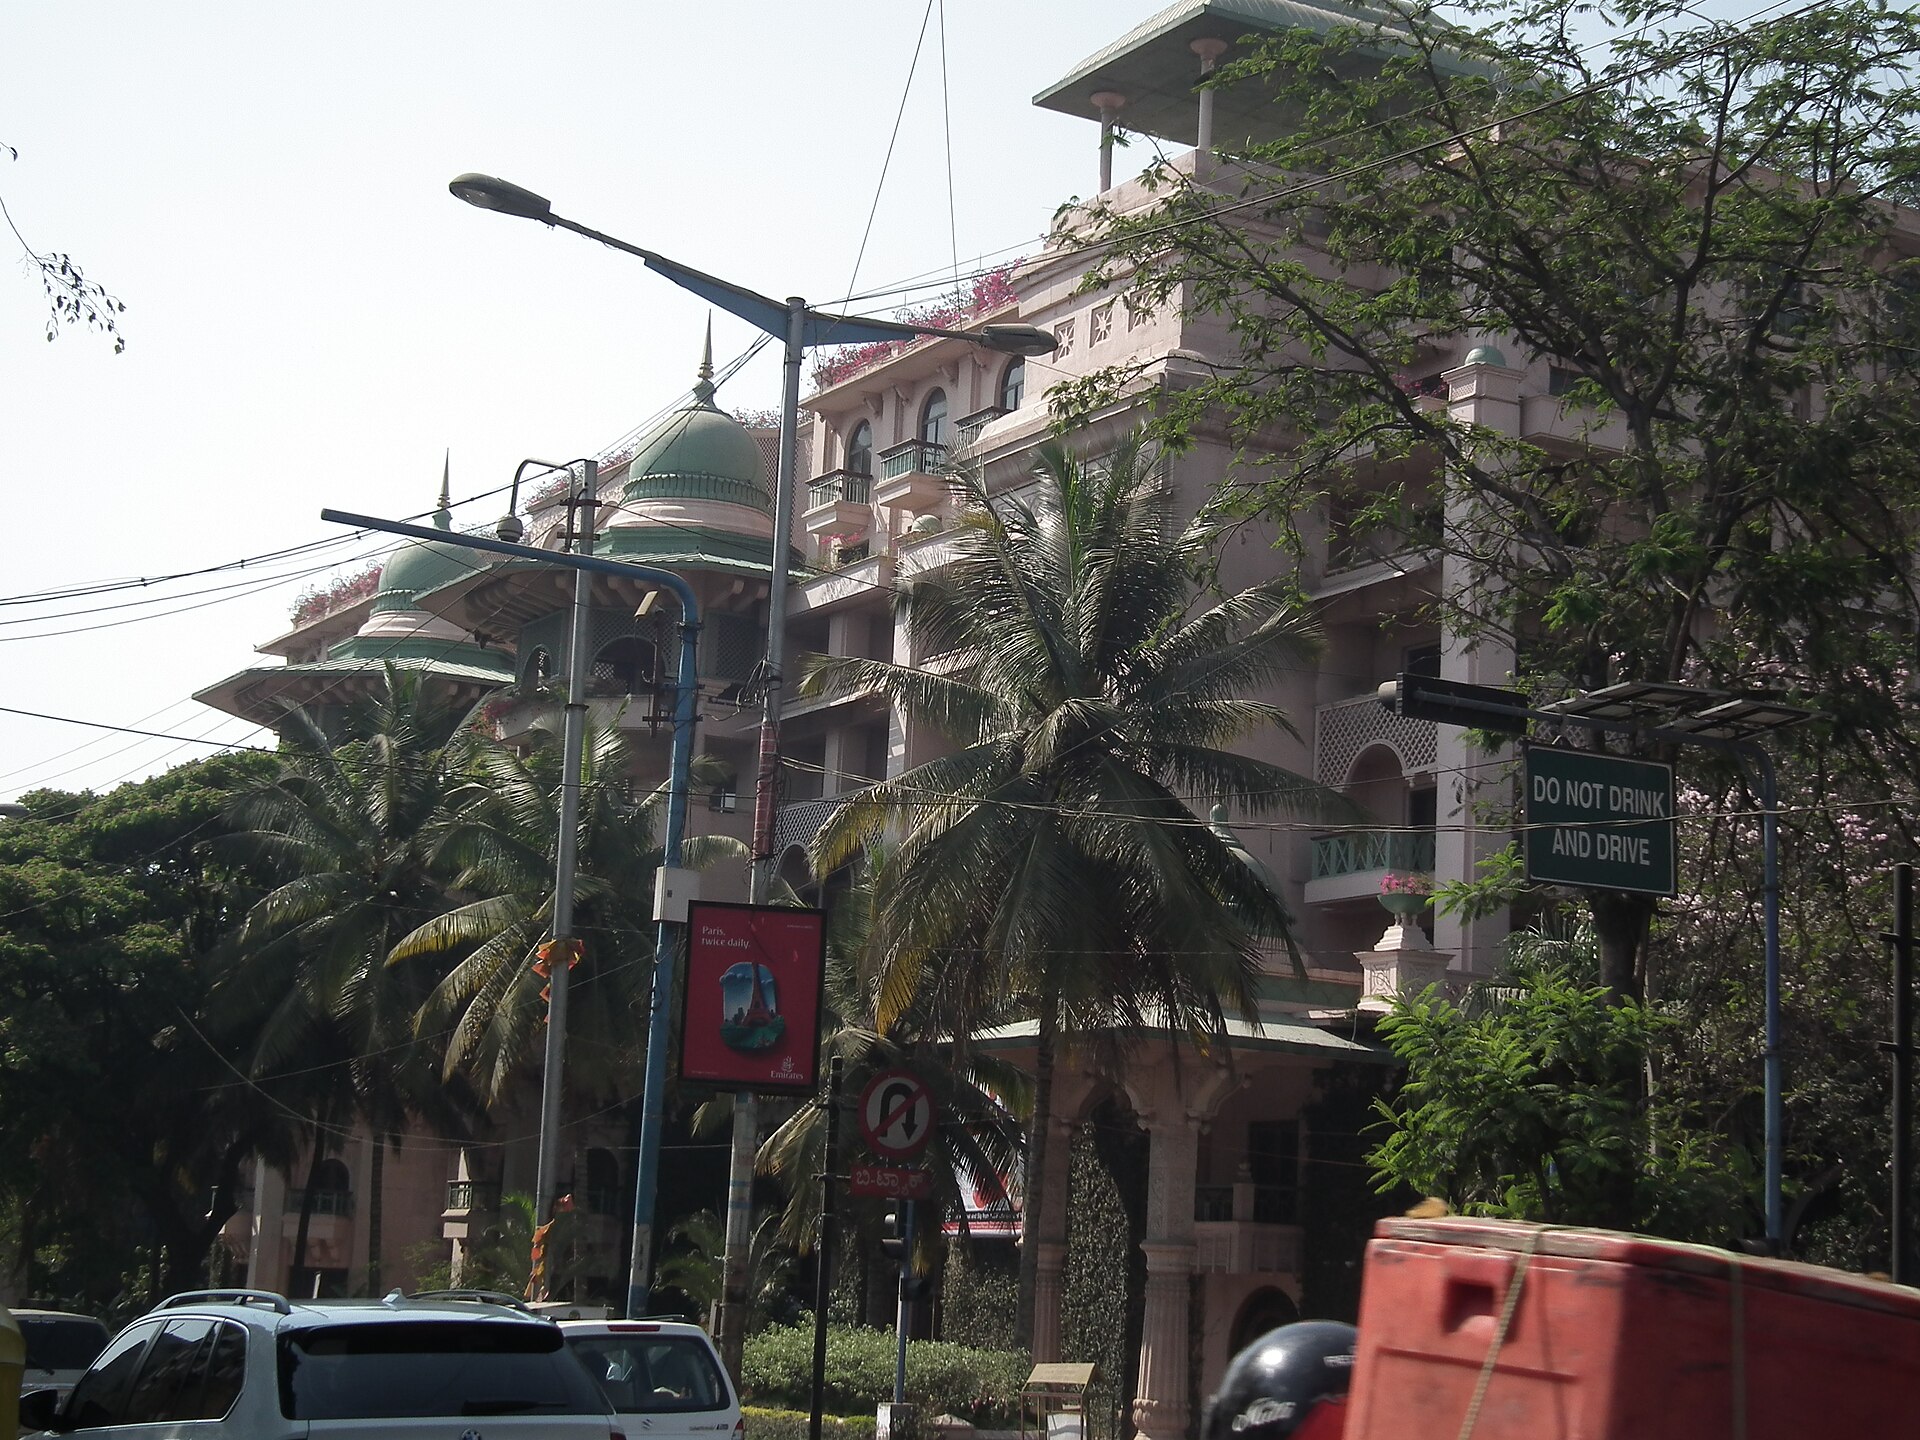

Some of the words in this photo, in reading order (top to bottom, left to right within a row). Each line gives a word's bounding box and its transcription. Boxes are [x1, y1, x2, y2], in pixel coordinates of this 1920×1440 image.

[1533, 775, 1560, 804] DO
[1566, 780, 1604, 809] NOT
[1609, 785, 1665, 818] DRINK
[1552, 828, 1591, 858] AND
[1597, 834, 1650, 866] DRIVE
[701, 937, 726, 946] twice
[770, 1070, 804, 1080] Emirates
